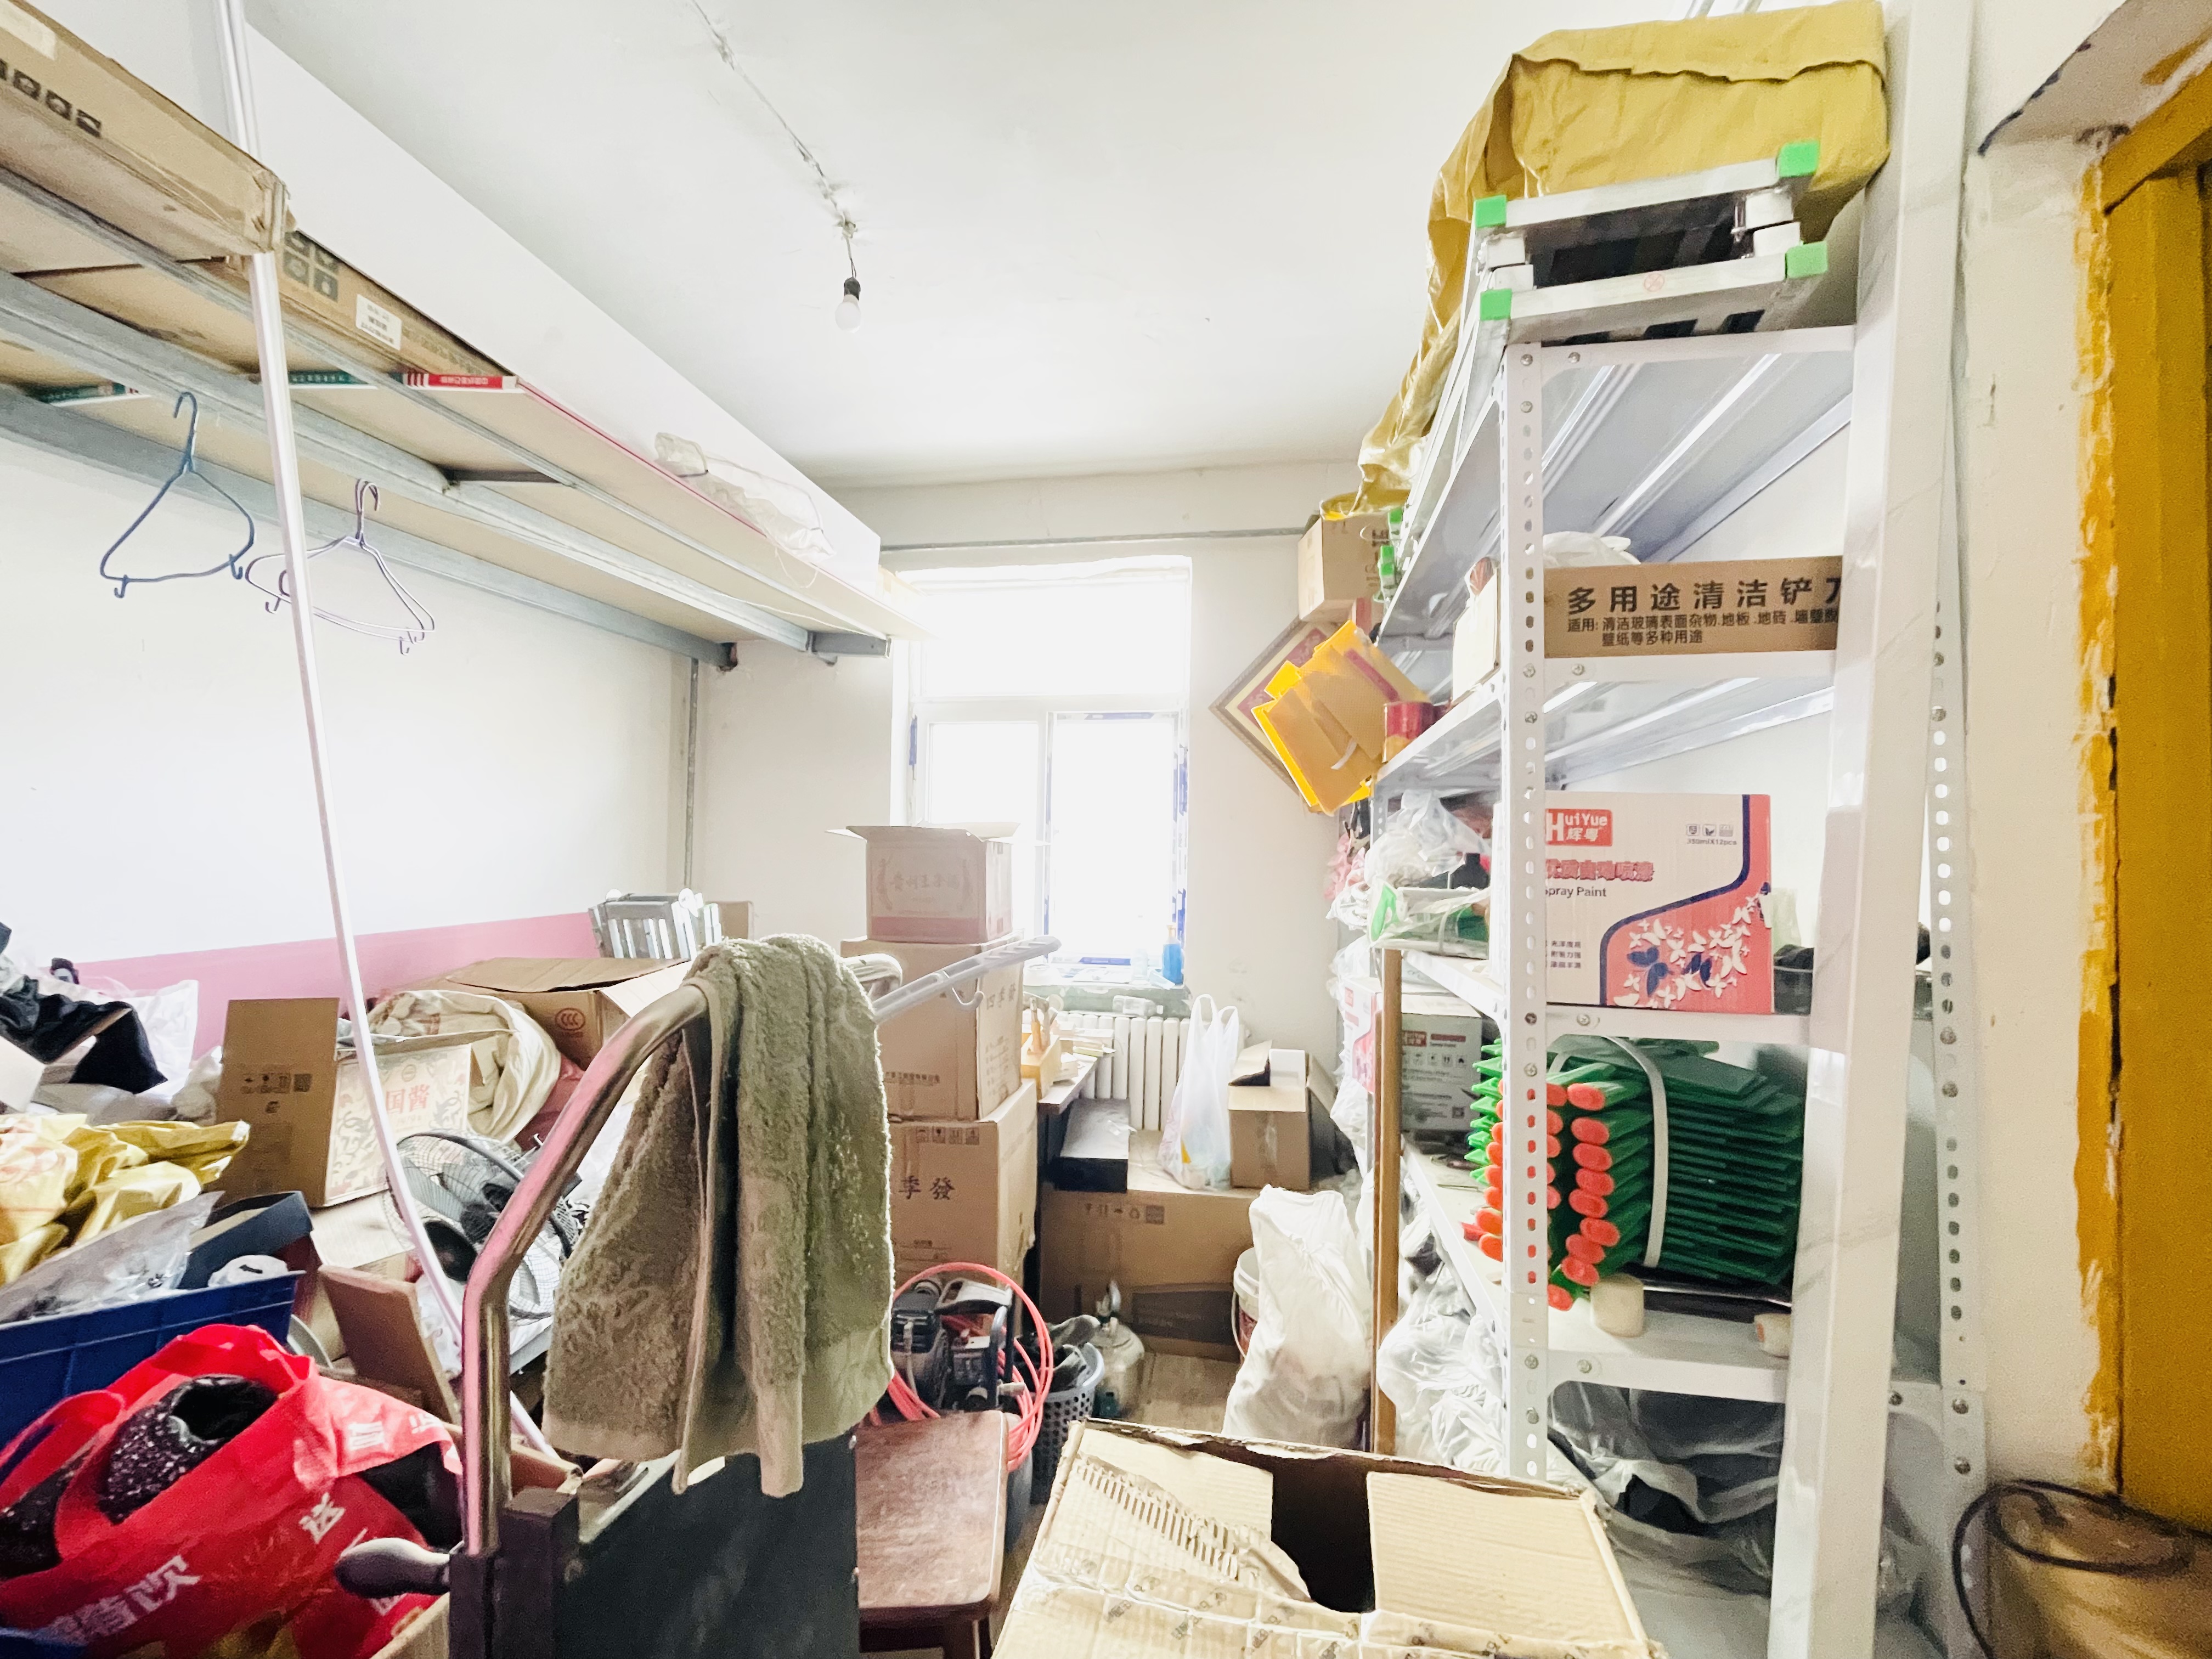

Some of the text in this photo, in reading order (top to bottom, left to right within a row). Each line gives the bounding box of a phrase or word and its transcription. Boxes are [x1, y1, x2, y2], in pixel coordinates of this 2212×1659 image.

[1602, 629, 1703, 647] 壁纸等多种用途
[1577, 886, 1607, 897] Paint
